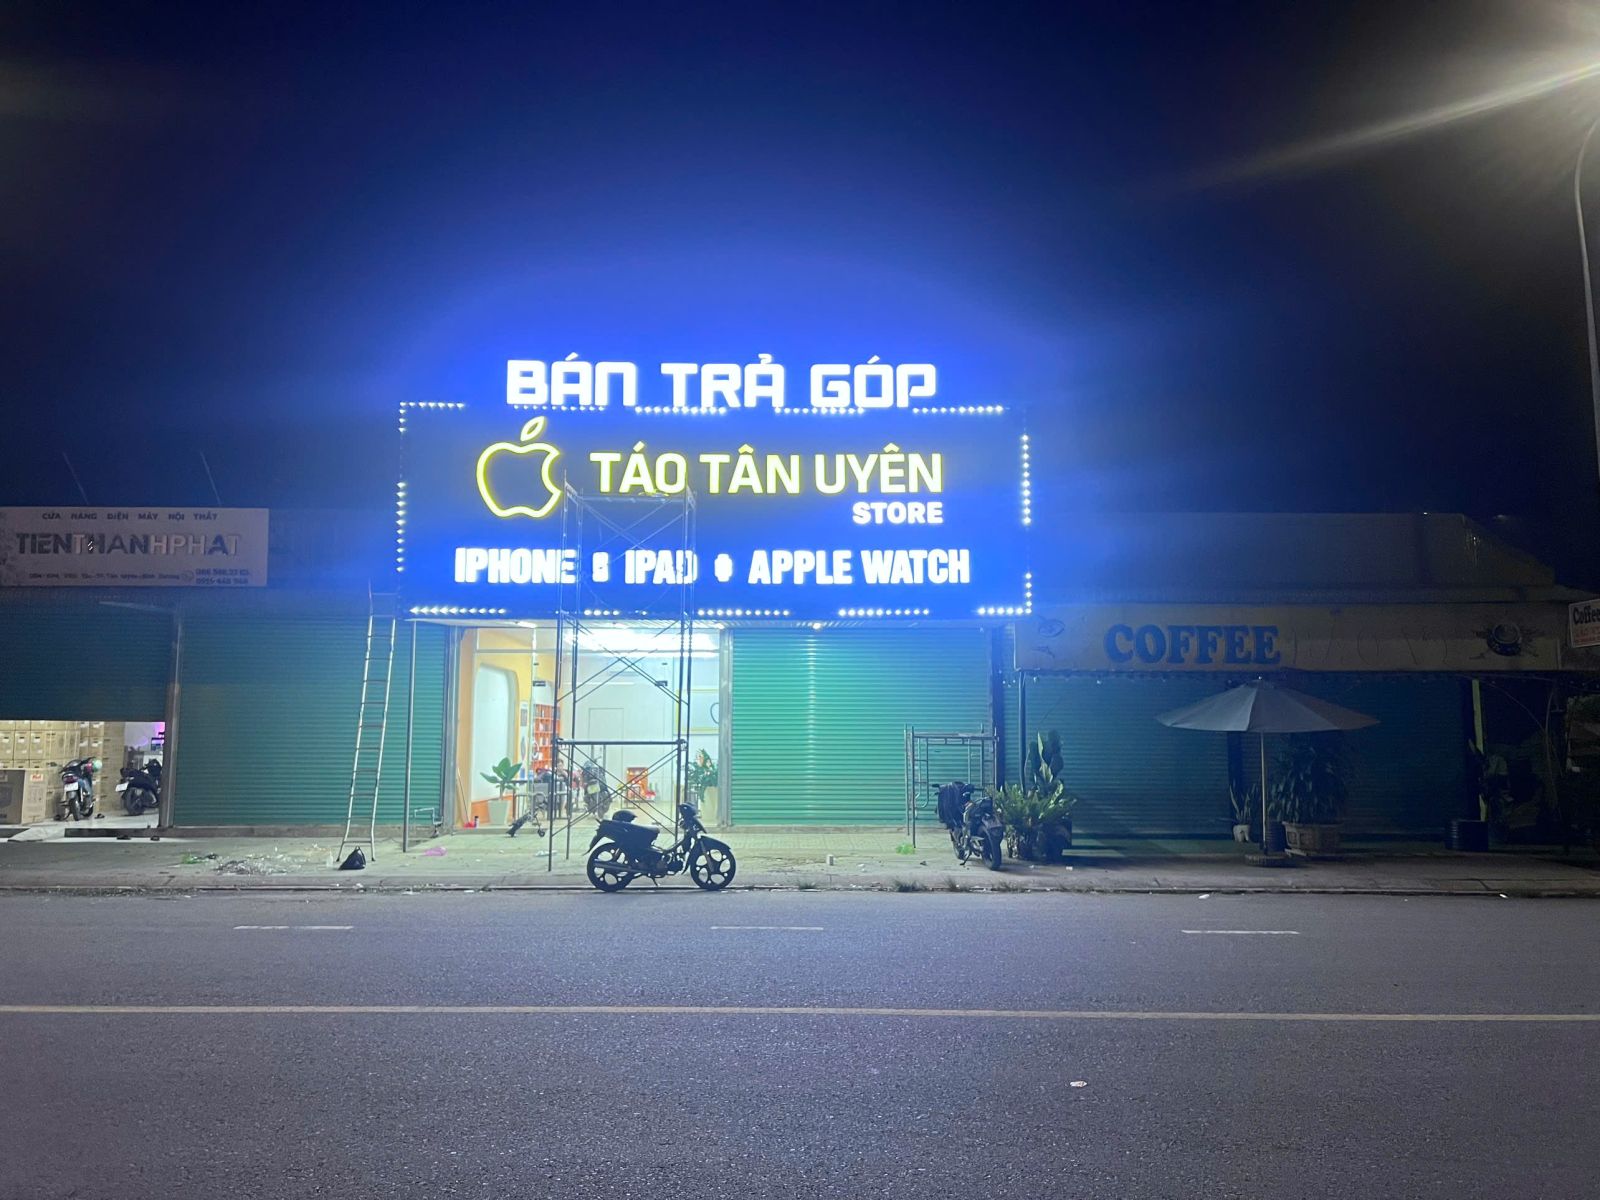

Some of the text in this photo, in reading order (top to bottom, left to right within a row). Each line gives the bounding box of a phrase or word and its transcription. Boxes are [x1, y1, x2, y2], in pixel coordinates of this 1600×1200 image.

[507, 352, 937, 409] BÁN TRẢ GÓP
[590, 441, 942, 494] TÁO TÂN UYÊN
[852, 501, 943, 524] STORE
[454, 547, 970, 584] IPHONE IPAD APPLE WATCH
[1103, 623, 1281, 665] COFFEE
